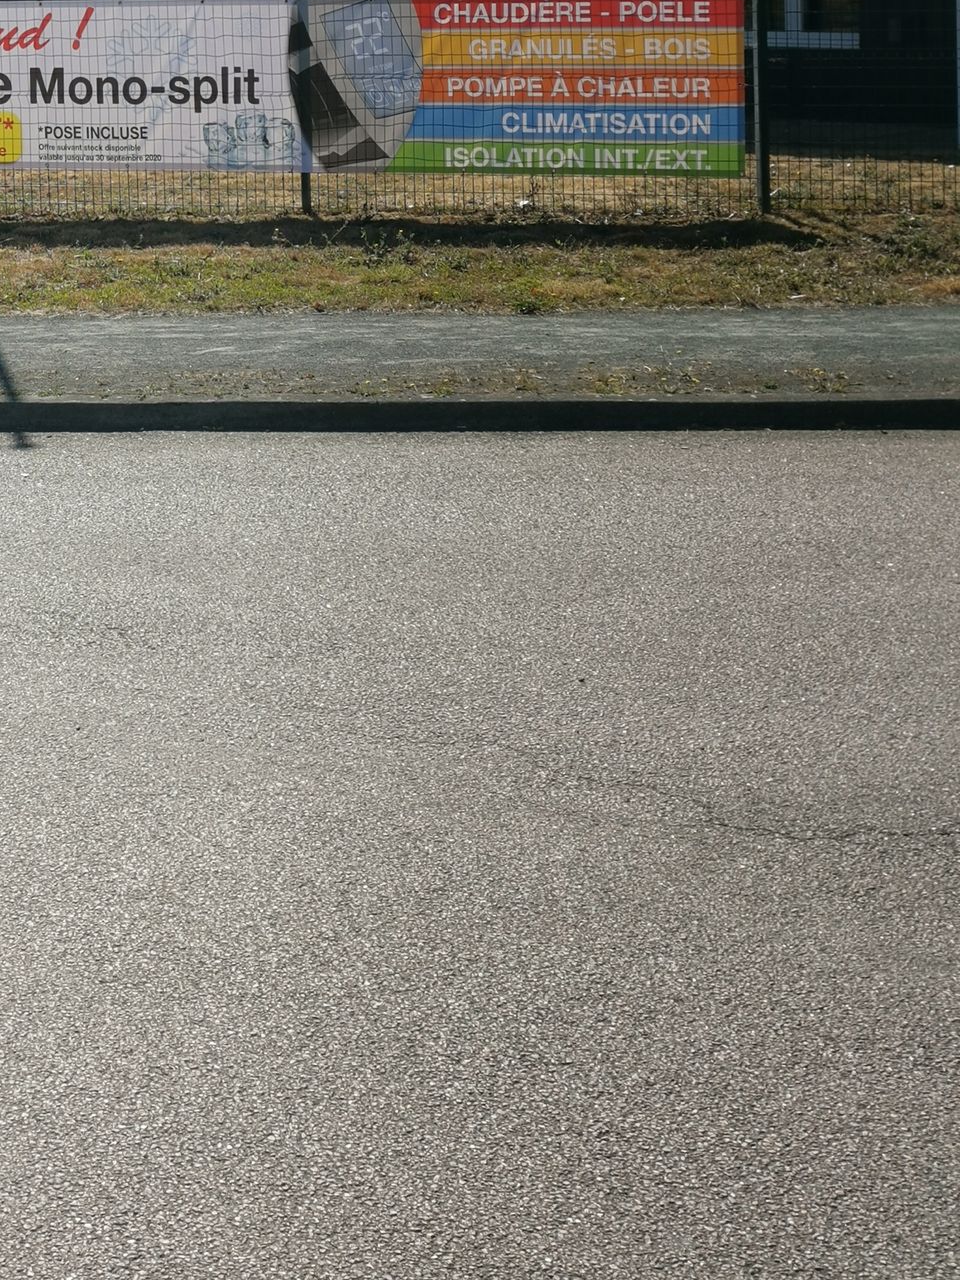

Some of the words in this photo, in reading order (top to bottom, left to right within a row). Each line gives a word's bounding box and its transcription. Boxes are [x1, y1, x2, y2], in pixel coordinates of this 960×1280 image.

[468, 33, 616, 60] GRANULÉS
[643, 38, 711, 60] BOIS
[30, 66, 260, 113] Mono-split
[447, 77, 543, 97] POMPE
[551, 71, 570, 97] À
[577, 77, 711, 98] CHALEUR
[86, 126, 148, 139] INCLUSE
[502, 113, 711, 135] CLIMATISATION
[38, 143, 55, 151] Offre
[84, 143, 103, 151] stock
[105, 143, 141, 153] disponible
[106, 154, 143, 162] septembre
[445, 147, 584, 169] ISOLATION
[594, 149, 711, 171] INT./EXT.
